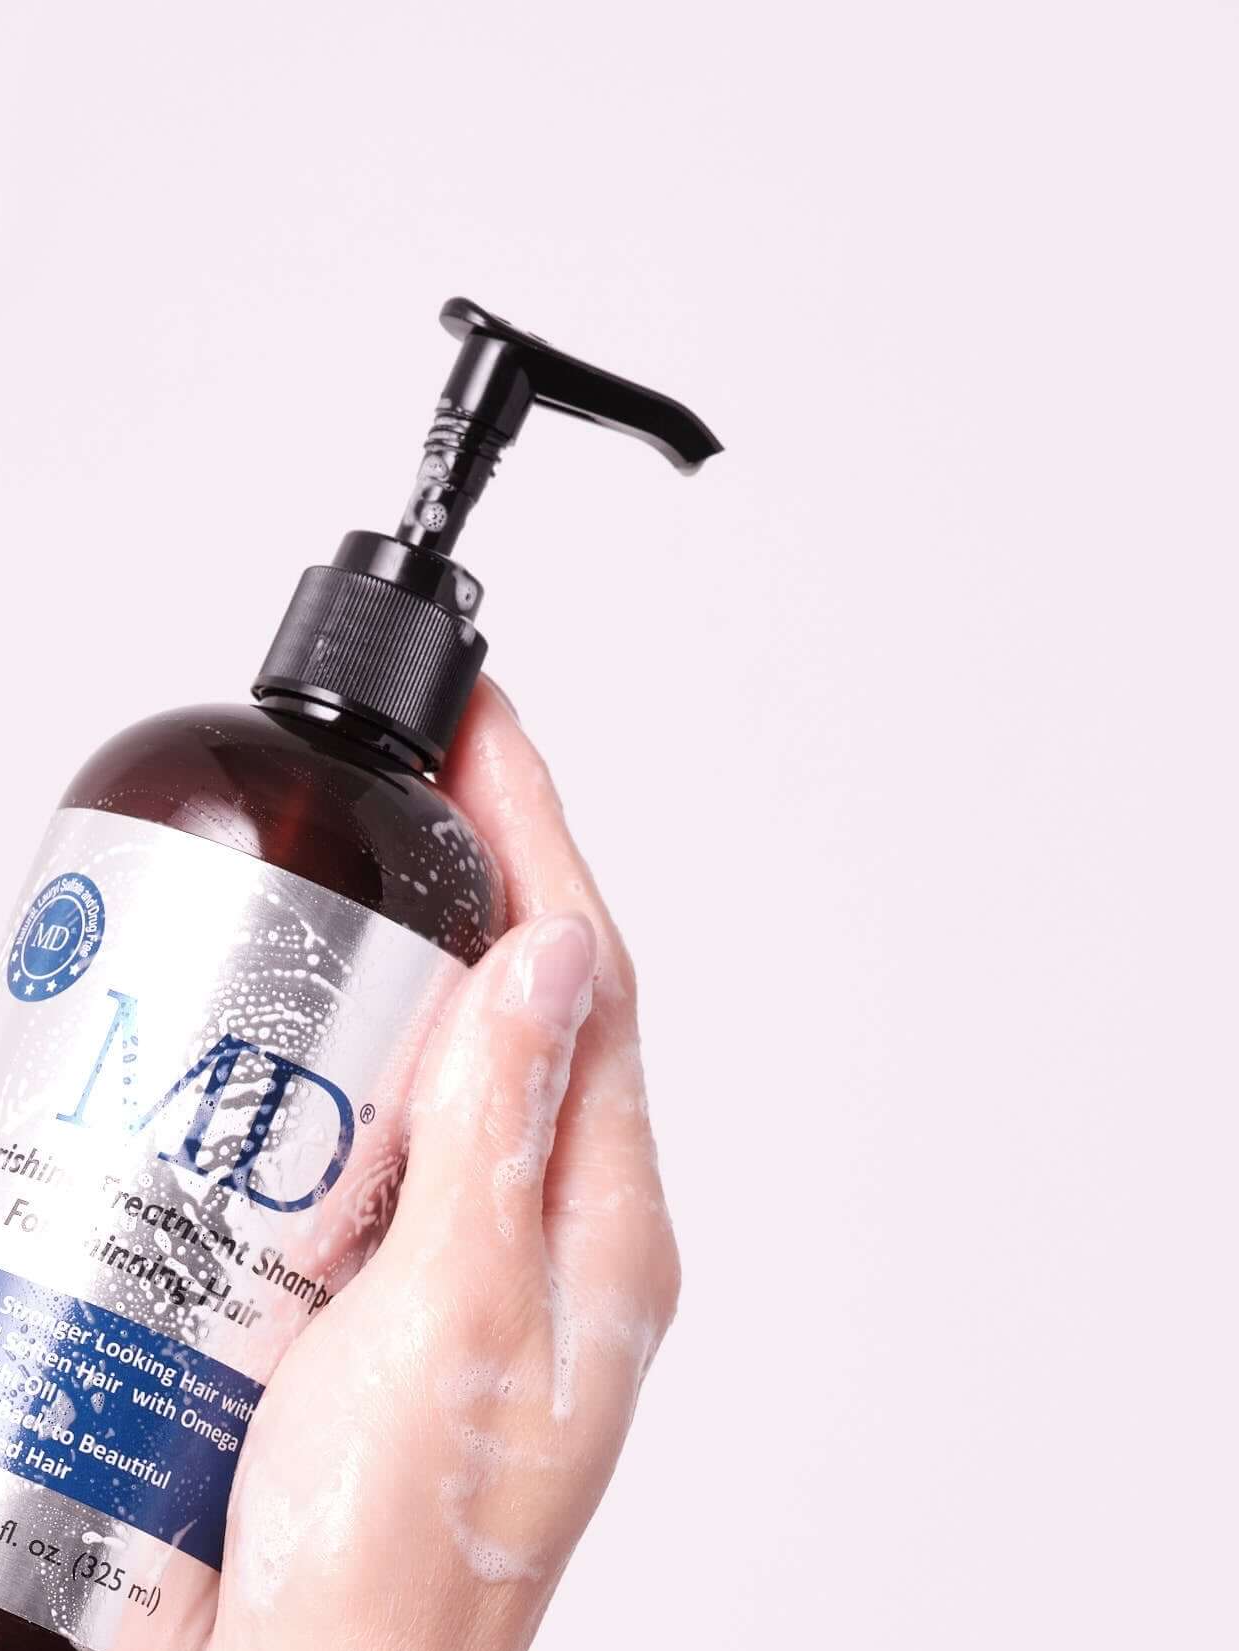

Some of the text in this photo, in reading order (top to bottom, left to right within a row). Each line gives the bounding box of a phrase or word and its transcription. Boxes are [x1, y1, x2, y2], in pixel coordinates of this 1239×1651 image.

[80, 935, 98, 958] Free
[86, 905, 100, 933] Drug
[102, 1173, 250, 1266] reatment
[199, 1277, 262, 1329] Hair
[75, 1360, 124, 1395] Hair
[132, 1387, 178, 1421] with
[180, 1408, 239, 1453] Omega
[94, 1332, 178, 1388] Looking
[178, 1370, 220, 1404] Hair
[221, 1394, 257, 1424] with
[25, 1446, 73, 1480] Hair
[51, 1422, 75, 1446] to
[78, 1432, 172, 1490] Beautiful
[28, 1539, 62, 1566] oz.
[71, 1552, 126, 1592] (325
[127, 1583, 162, 1617] ml)
